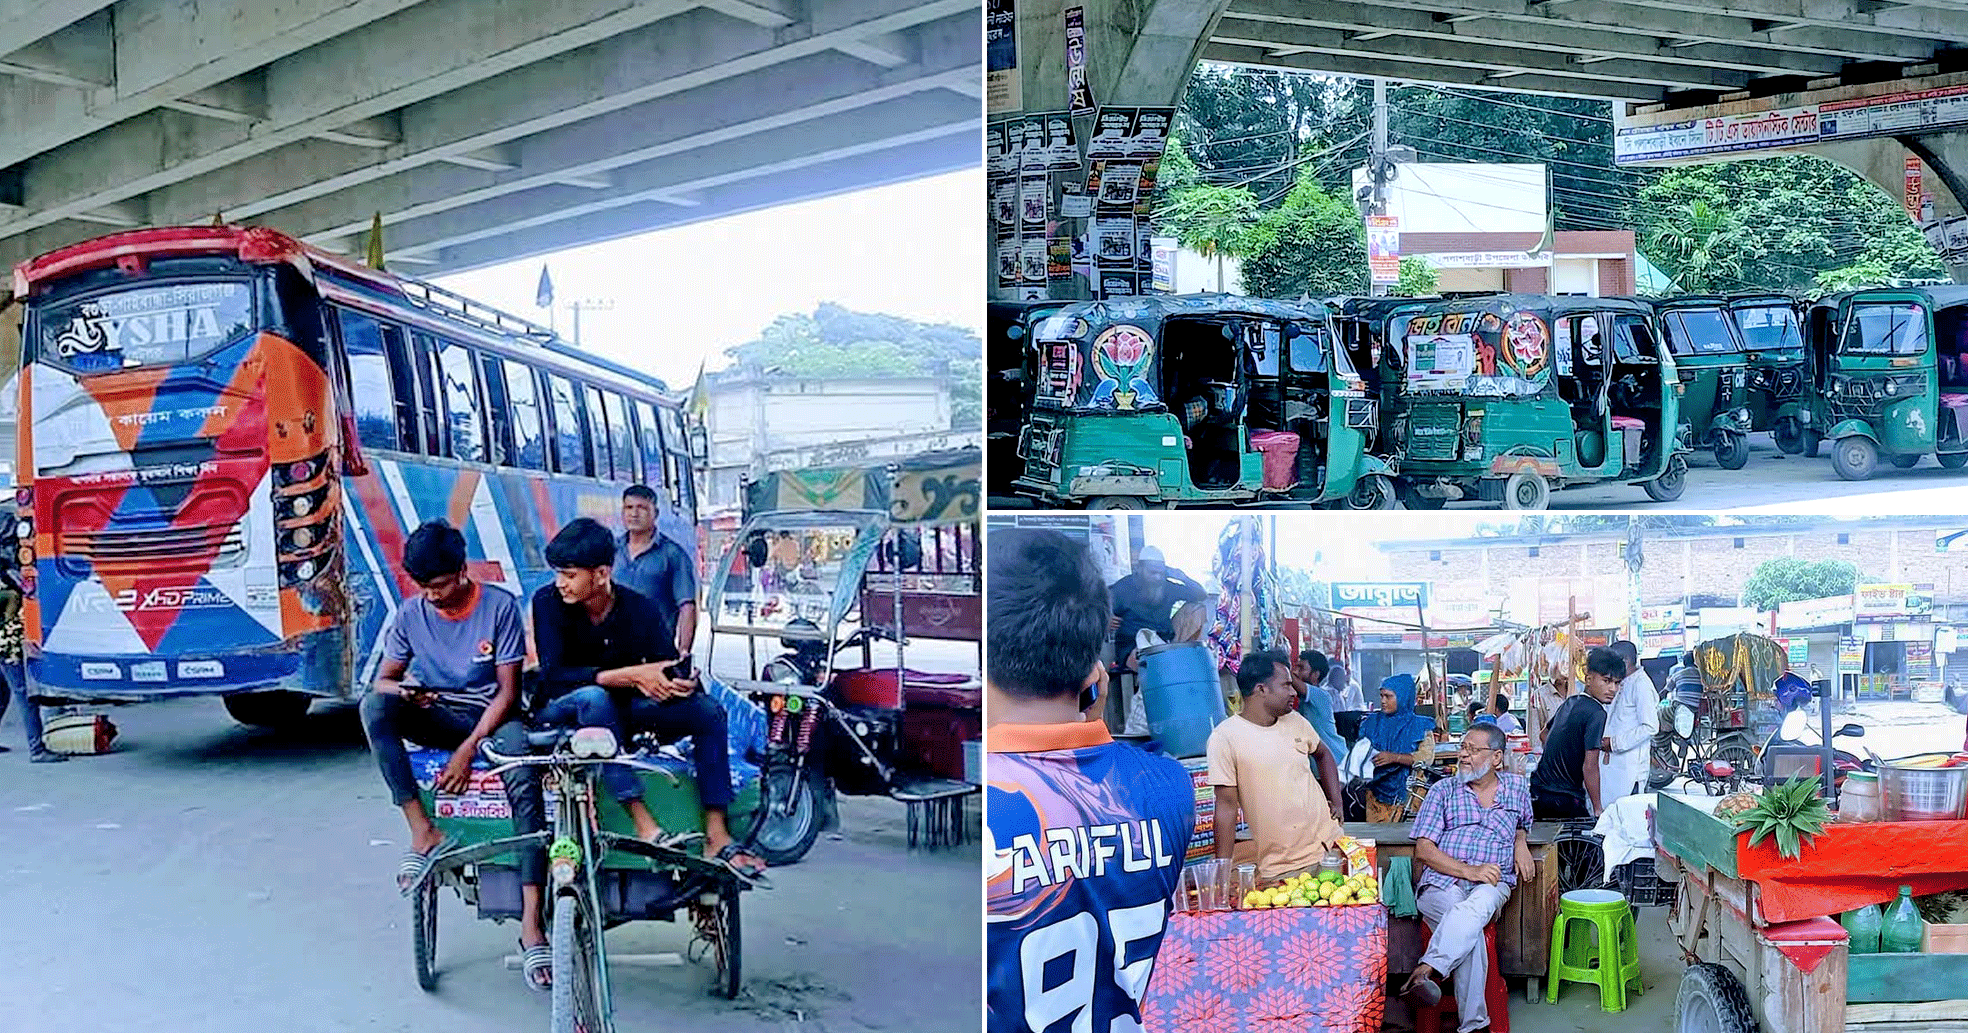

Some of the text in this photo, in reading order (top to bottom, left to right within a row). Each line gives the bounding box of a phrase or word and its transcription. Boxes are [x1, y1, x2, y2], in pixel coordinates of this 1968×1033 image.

[1791, 110, 1817, 136] সেন্টার
[58, 304, 222, 357] AYSHA
[1012, 818, 1172, 895] ARIFUL
